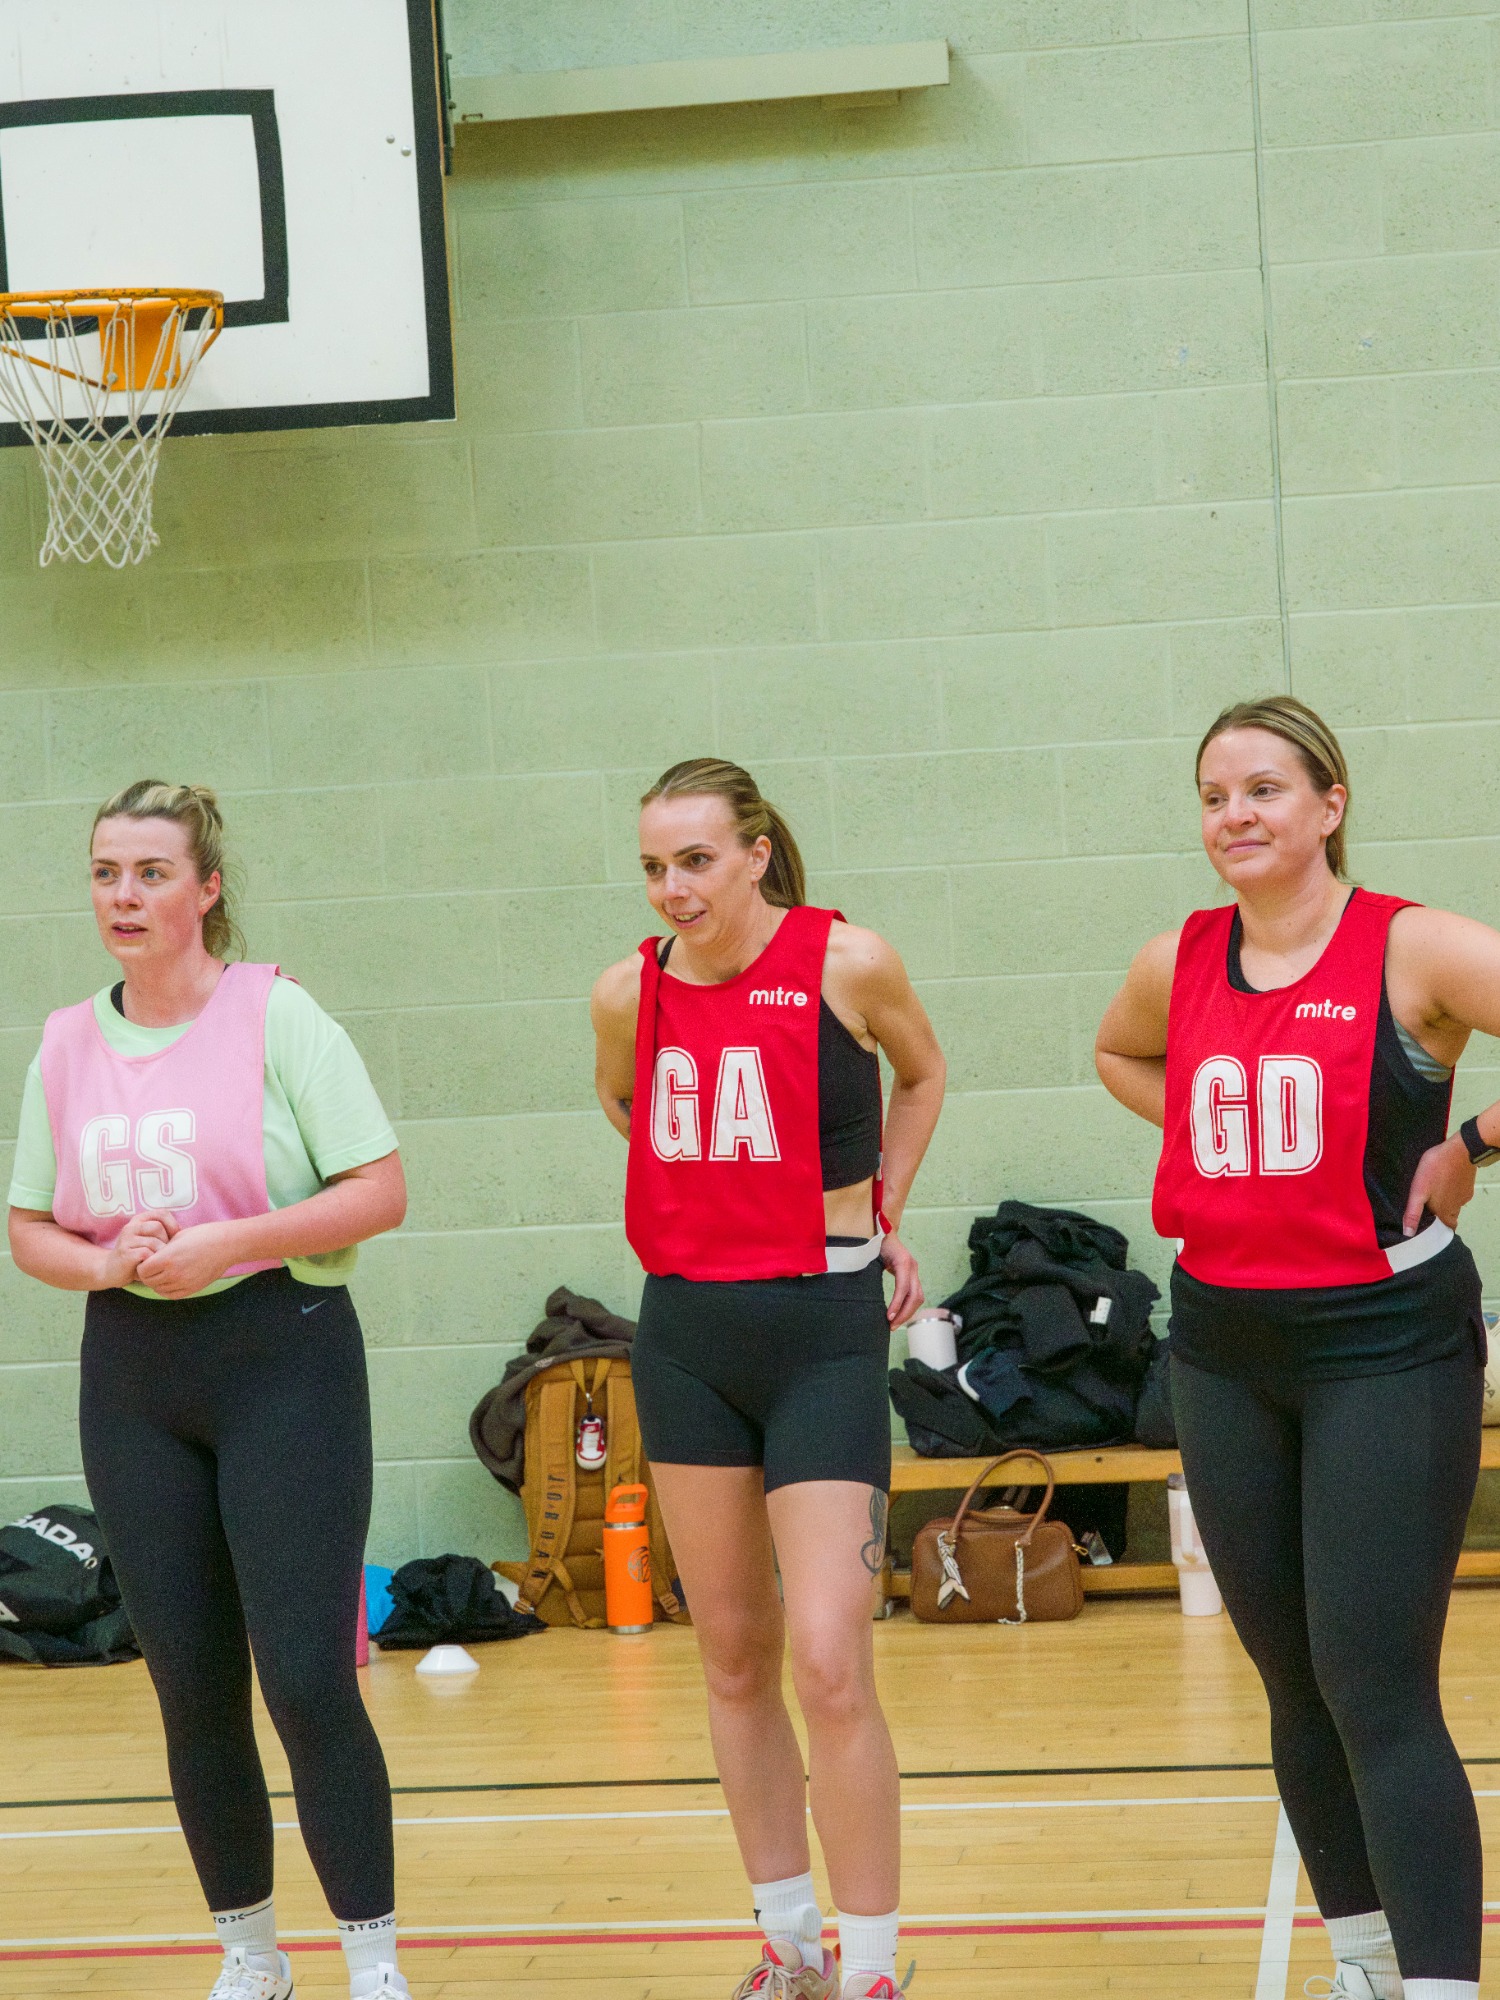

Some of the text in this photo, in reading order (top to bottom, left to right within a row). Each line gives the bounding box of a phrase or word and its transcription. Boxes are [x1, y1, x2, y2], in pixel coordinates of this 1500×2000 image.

[749, 986, 808, 1007] mitre
[1295, 999, 1356, 1021] mitre
[651, 1046, 782, 1162] GA
[1190, 1055, 1323, 1179] GD
[80, 1108, 198, 1217] GS
